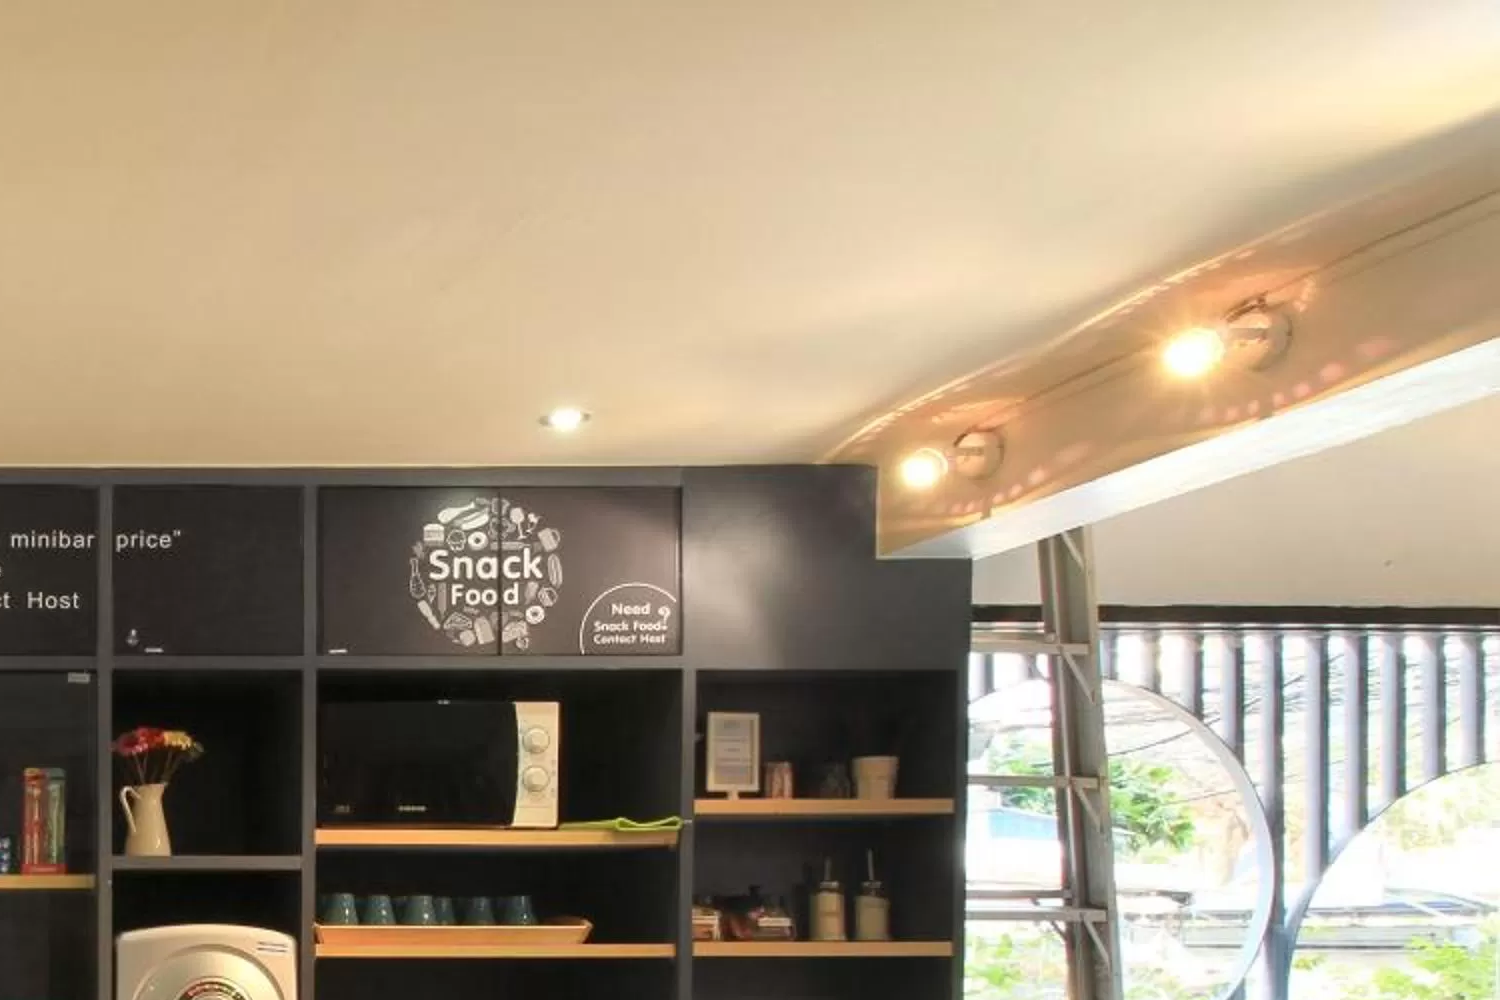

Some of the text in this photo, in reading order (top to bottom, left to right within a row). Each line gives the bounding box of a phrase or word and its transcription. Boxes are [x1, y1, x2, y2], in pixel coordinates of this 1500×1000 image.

[10, 529, 95, 549] minibar
[428, 547, 545, 581] Snack
[27, 591, 80, 610] Host
[450, 582, 520, 606] Food
[611, 603, 651, 616] Need
[594, 620, 629, 632] Snack
